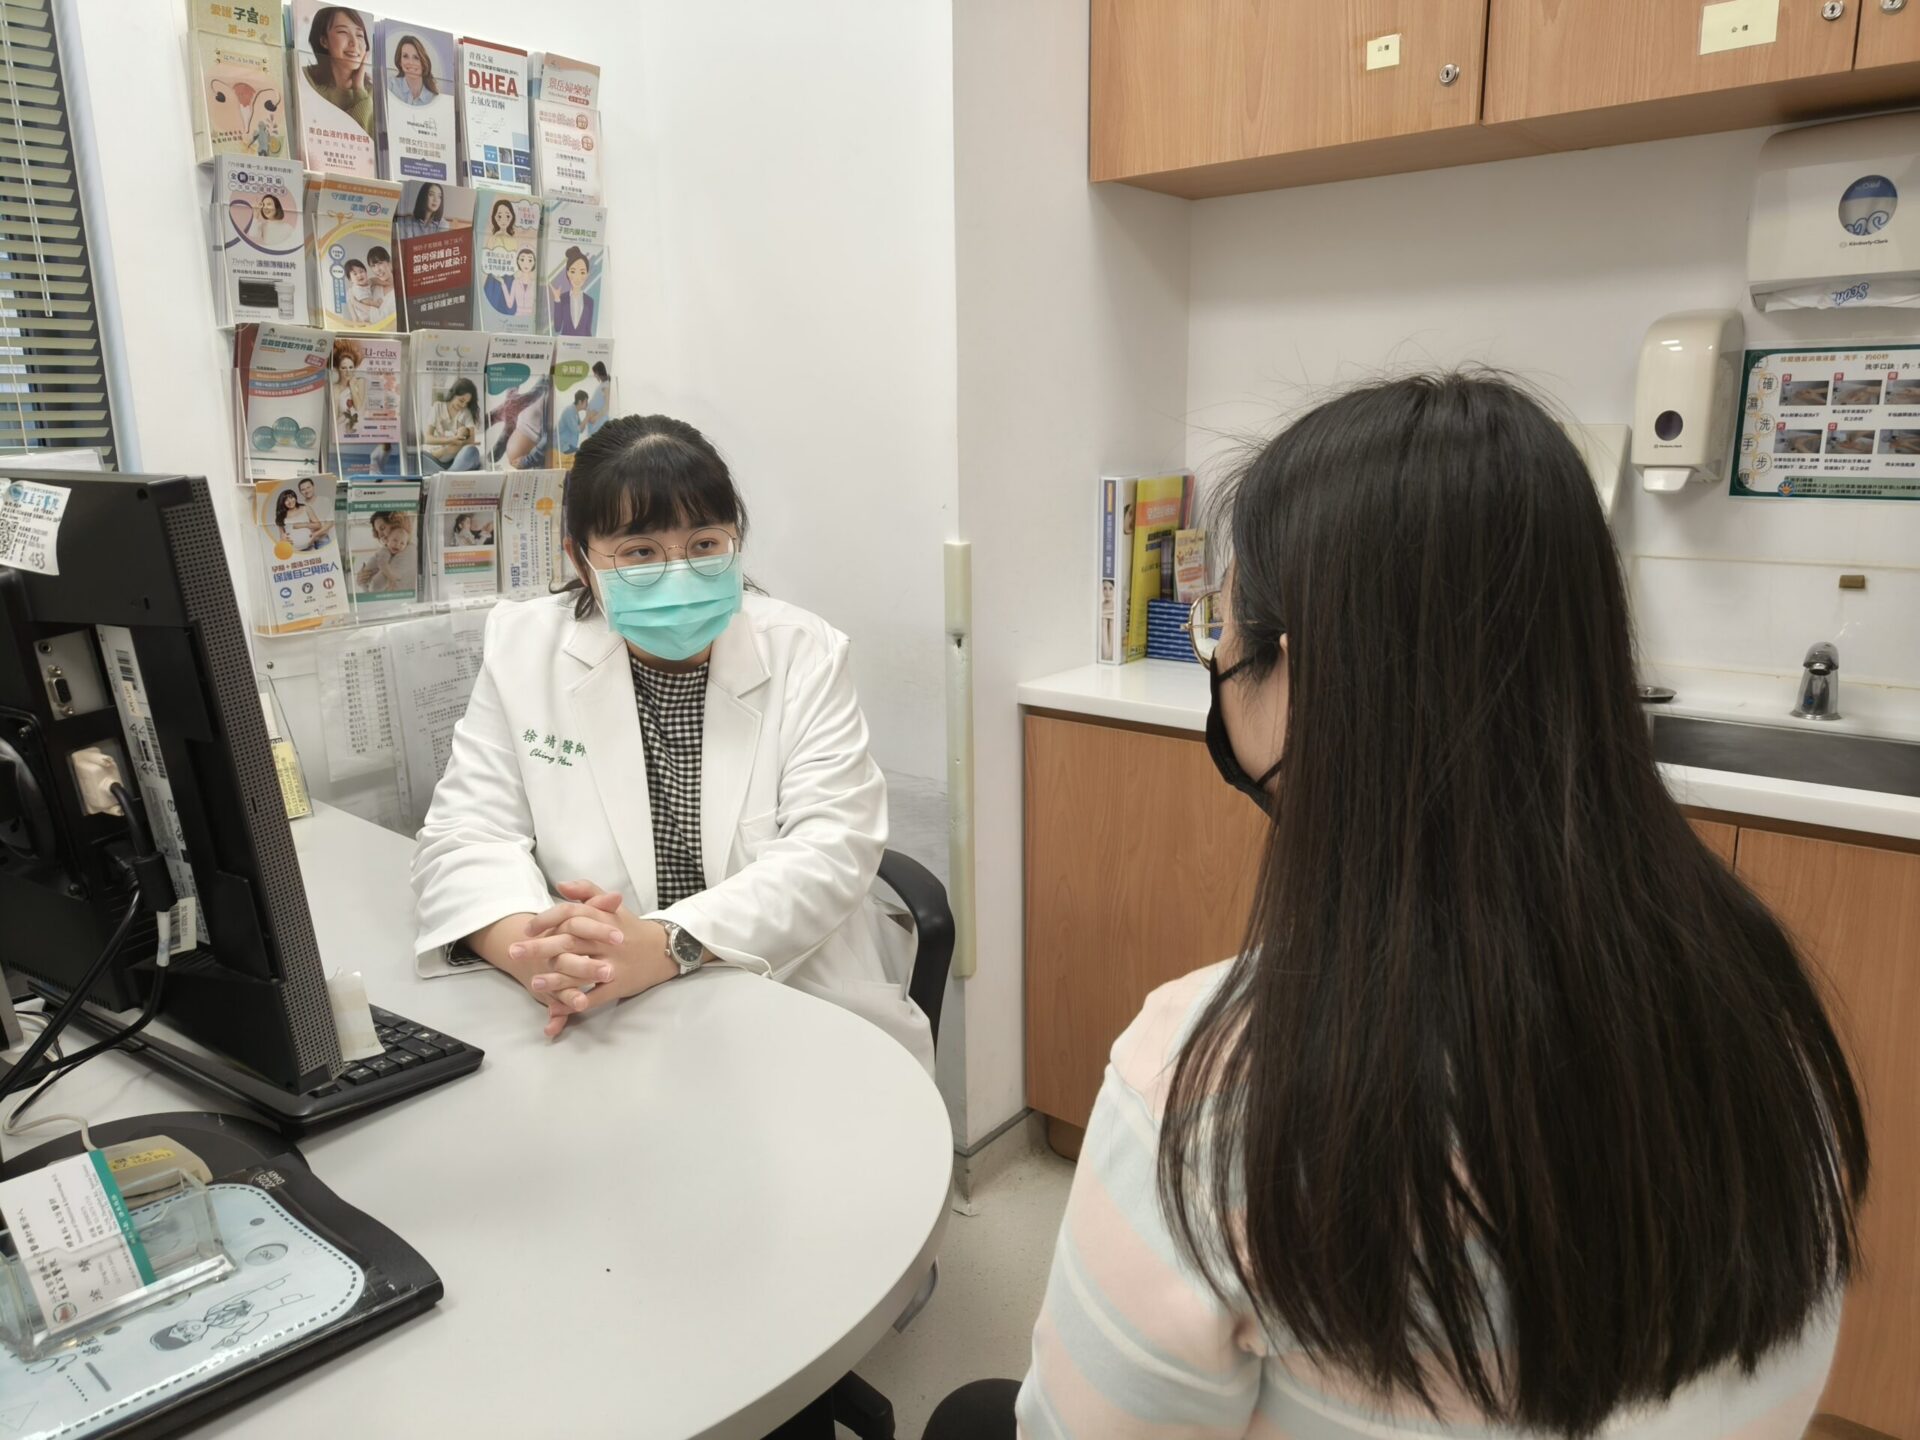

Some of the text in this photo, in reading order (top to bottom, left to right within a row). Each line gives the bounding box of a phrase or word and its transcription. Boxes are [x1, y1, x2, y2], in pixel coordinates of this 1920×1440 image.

[468, 68, 519, 97] DHEA
[1759, 416, 1770, 431] 洗
[1743, 438, 1753, 450] 手
[1756, 456, 1767, 470] 步
